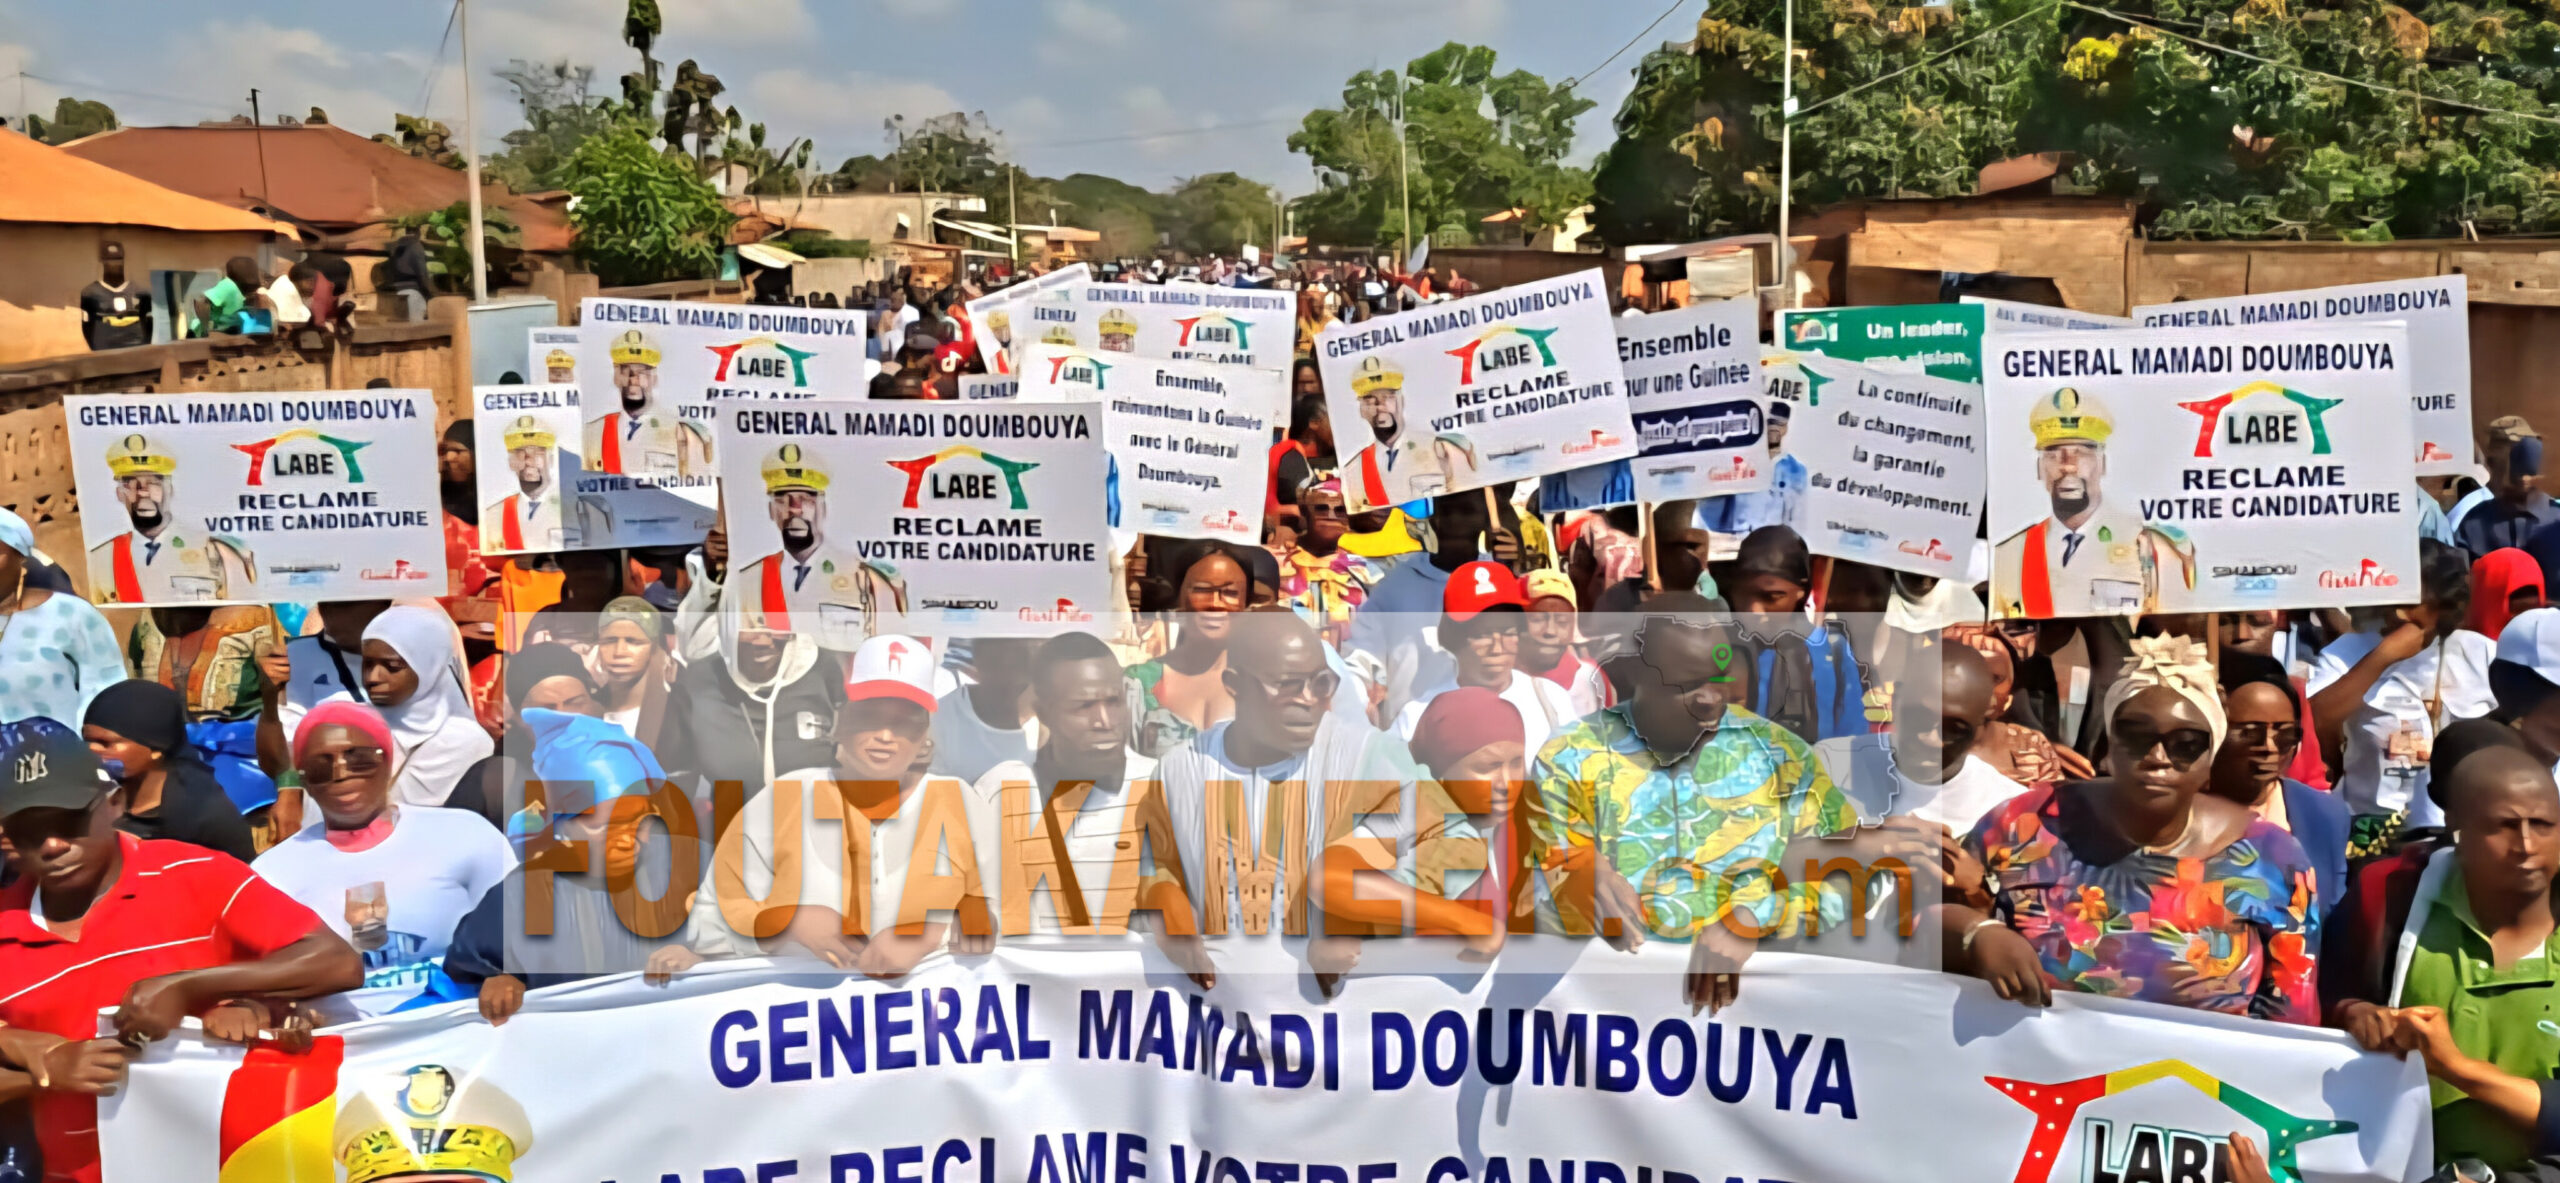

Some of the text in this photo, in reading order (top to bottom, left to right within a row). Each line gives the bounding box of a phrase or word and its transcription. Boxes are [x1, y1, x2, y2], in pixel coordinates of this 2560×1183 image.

[594, 304, 856, 336] GENERAL MAMADI DOUMBOUYA
[1327, 282, 1593, 357] GENERAL MAMADI DOUMBOUYA
[2241, 302, 2318, 325] MAMADI
[2326, 288, 2451, 317] DOUMBOUYA
[1617, 323, 1731, 362] Ensemble
[1867, 324, 1893, 339] Un
[737, 356, 785, 378] LABE
[1481, 344, 1531, 372] LABE
[2003, 343, 2393, 378] GENERAL MAMADI DOUMBOUYA
[1455, 371, 1570, 408] RECLAME
[1654, 373, 1683, 394] une
[1858, 380, 1878, 398] La
[80, 398, 417, 427] GENERAL MAMADI DOUMBOUYA
[484, 394, 560, 410] GENERAL
[1431, 382, 1613, 431] VOTRE CANDIDATURE
[737, 411, 1090, 440] GENERAL MAMADI DOUMBOUYA
[1865, 416, 1976, 453] changement,
[2228, 414, 2297, 444] LABE
[274, 453, 335, 476] LABE
[1853, 445, 1945, 478] la garantie
[577, 478, 629, 493] VOTRE
[932, 473, 997, 499] LABE
[2183, 466, 2345, 491] RECLAME
[239, 492, 379, 510] RECLAME
[2140, 492, 2401, 522] VOTRE CANDIDATURE
[205, 511, 429, 532] VOTRE CANDIDATURE
[893, 518, 1042, 537] RECLAME
[857, 540, 1096, 561] VOTRE CANDIDATURE
[710, 984, 1858, 1120] GENERAL MAMADI DOUMBOUYA
